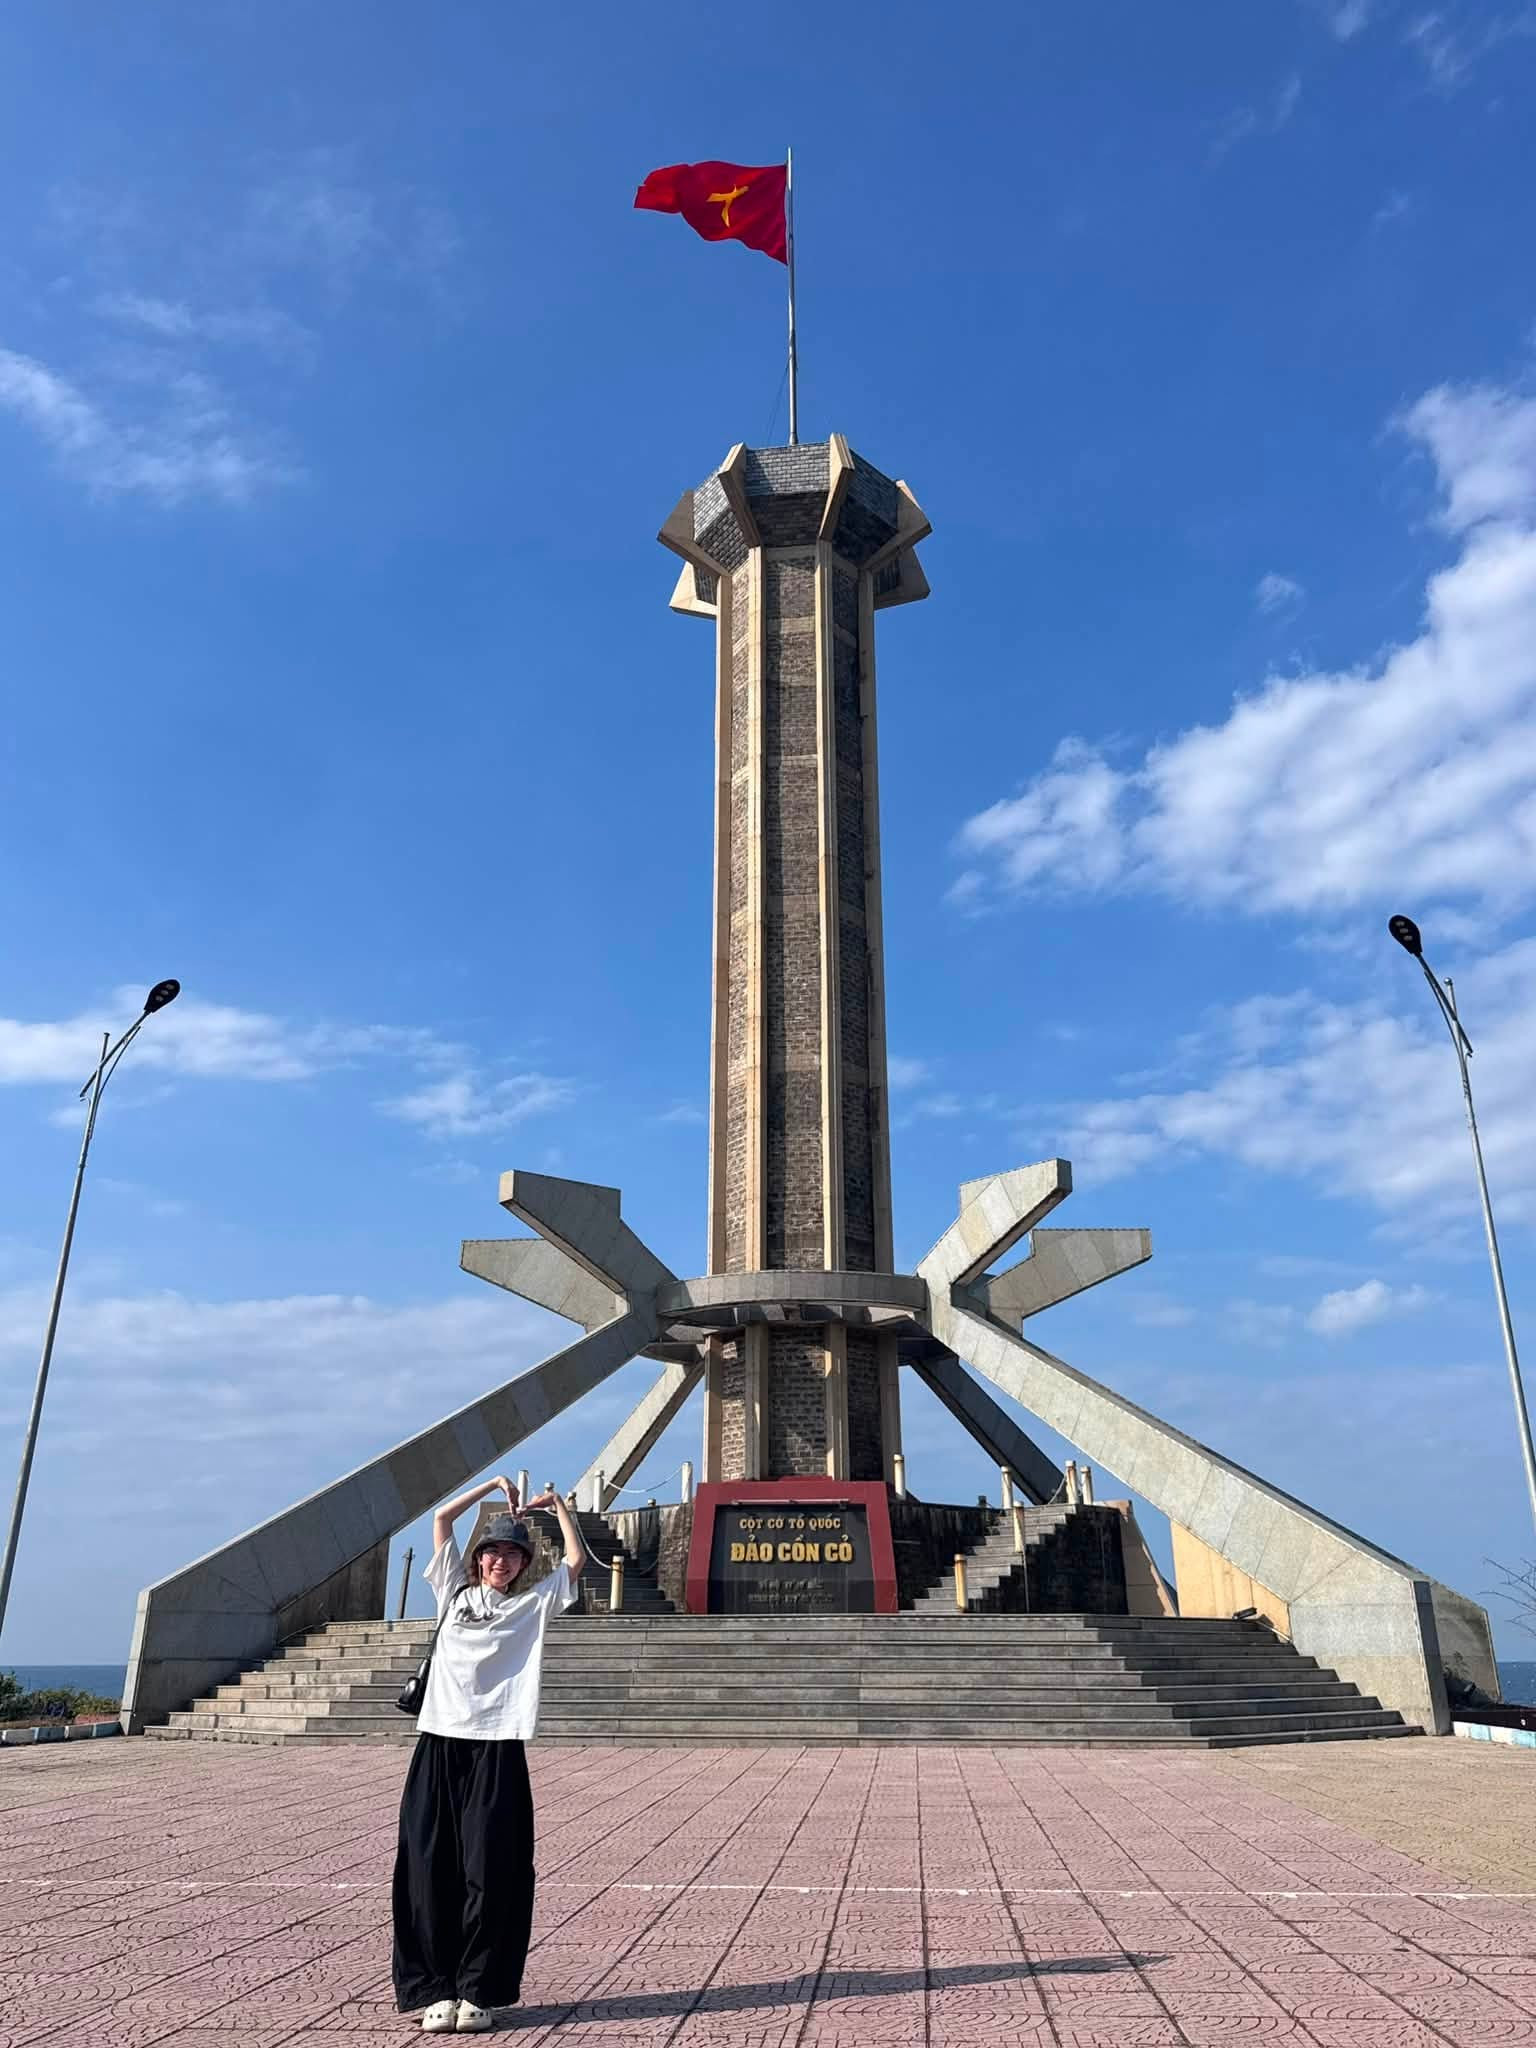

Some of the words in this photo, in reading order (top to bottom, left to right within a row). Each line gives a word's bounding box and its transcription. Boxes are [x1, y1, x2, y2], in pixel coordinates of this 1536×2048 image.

[809, 1513, 841, 1531] QUỐC
[730, 1534, 774, 1562] ĐẢO
[824, 1534, 853, 1562] CỎ
